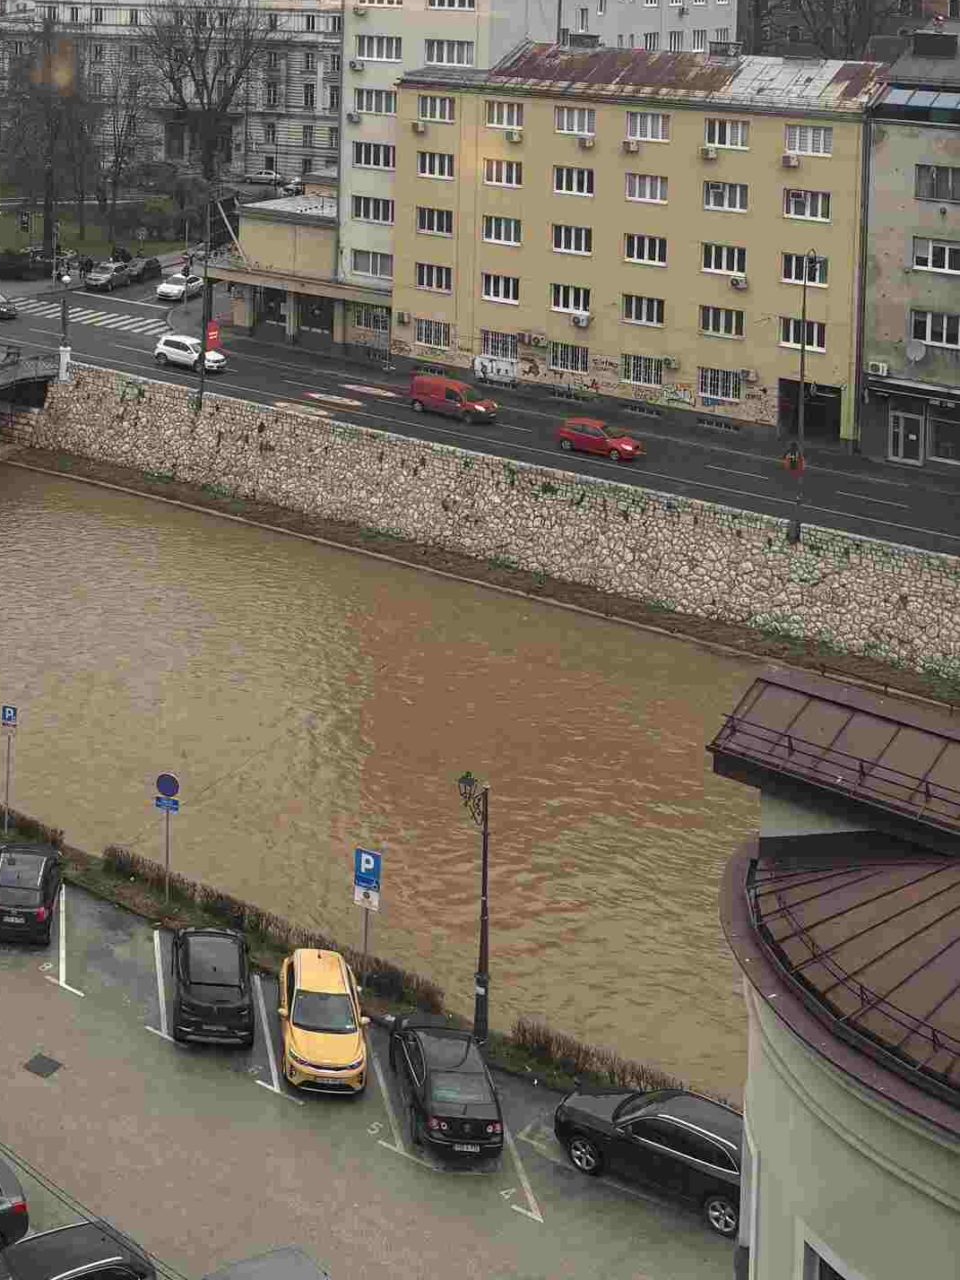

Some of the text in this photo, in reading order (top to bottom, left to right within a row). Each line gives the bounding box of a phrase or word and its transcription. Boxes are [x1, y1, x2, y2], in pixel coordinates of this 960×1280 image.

[5, 708, 14, 720] P
[360, 852, 375, 873] P
[38, 962, 53, 972] 8
[367, 1121, 383, 1135] 5
